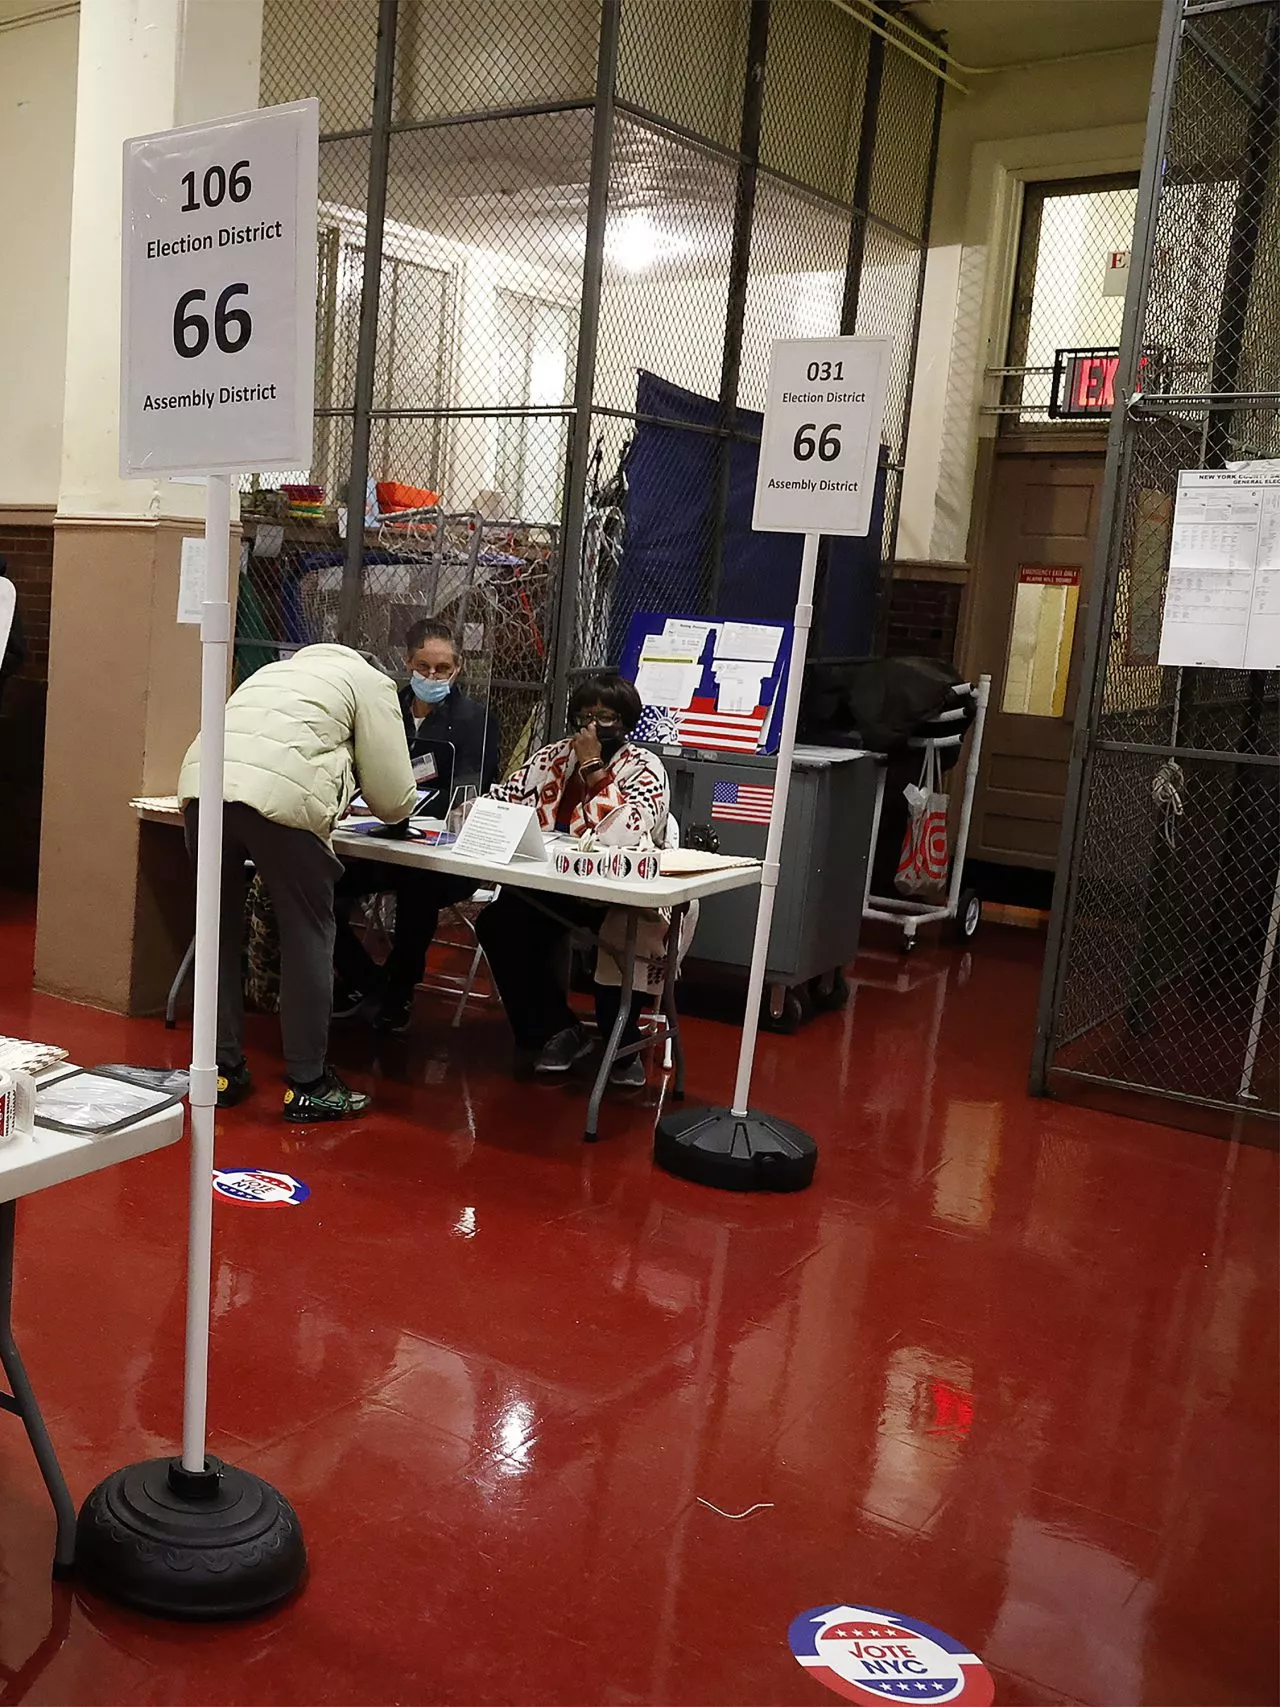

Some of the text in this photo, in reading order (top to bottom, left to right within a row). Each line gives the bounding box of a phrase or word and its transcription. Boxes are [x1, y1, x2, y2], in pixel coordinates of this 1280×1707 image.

[180, 160, 252, 212] 106
[147, 220, 282, 259] Election District
[173, 283, 252, 358] 66
[807, 361, 844, 381] 031
[143, 383, 276, 411] Assembly District
[782, 391, 865, 404] Election District
[793, 423, 842, 462] 66
[768, 478, 858, 492] Assembly District
[848, 1641, 916, 1659] VOTE
[860, 1659, 928, 1675] NYC
